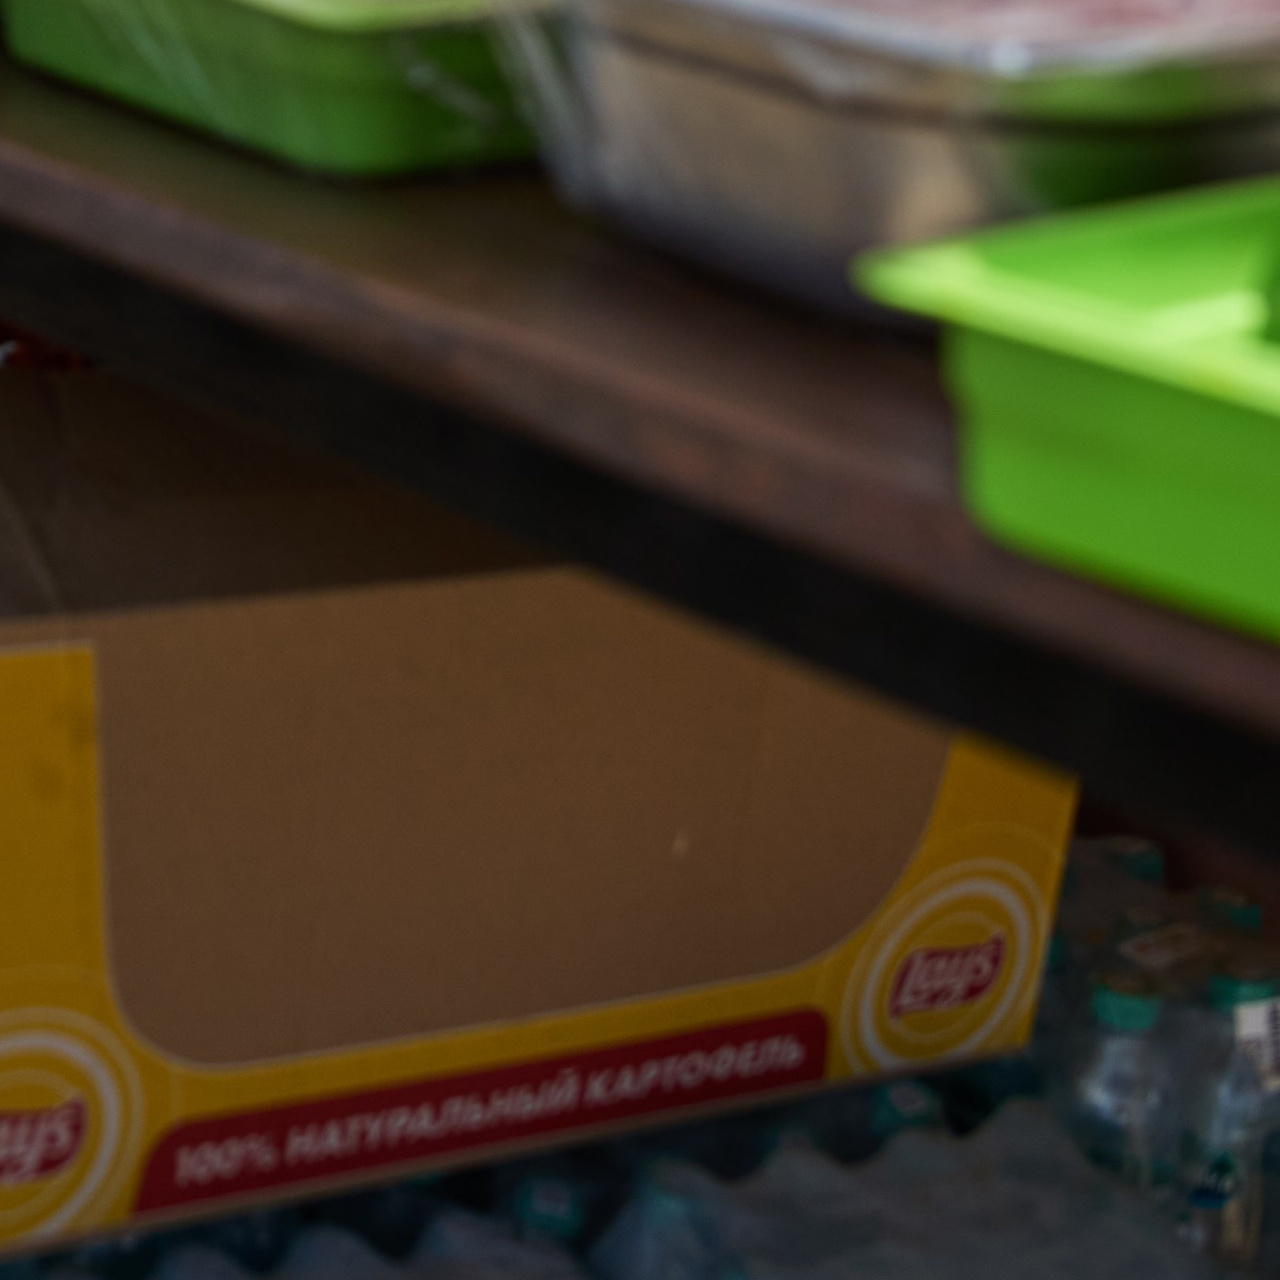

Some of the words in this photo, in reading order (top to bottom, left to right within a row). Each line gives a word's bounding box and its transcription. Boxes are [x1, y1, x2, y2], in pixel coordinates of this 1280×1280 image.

[174, 1131, 278, 1187] 100%
[284, 1067, 581, 1166] НАТУРАЛЬНЫЙ
[584, 1034, 806, 1108] КАРТОФЕЛЬ
